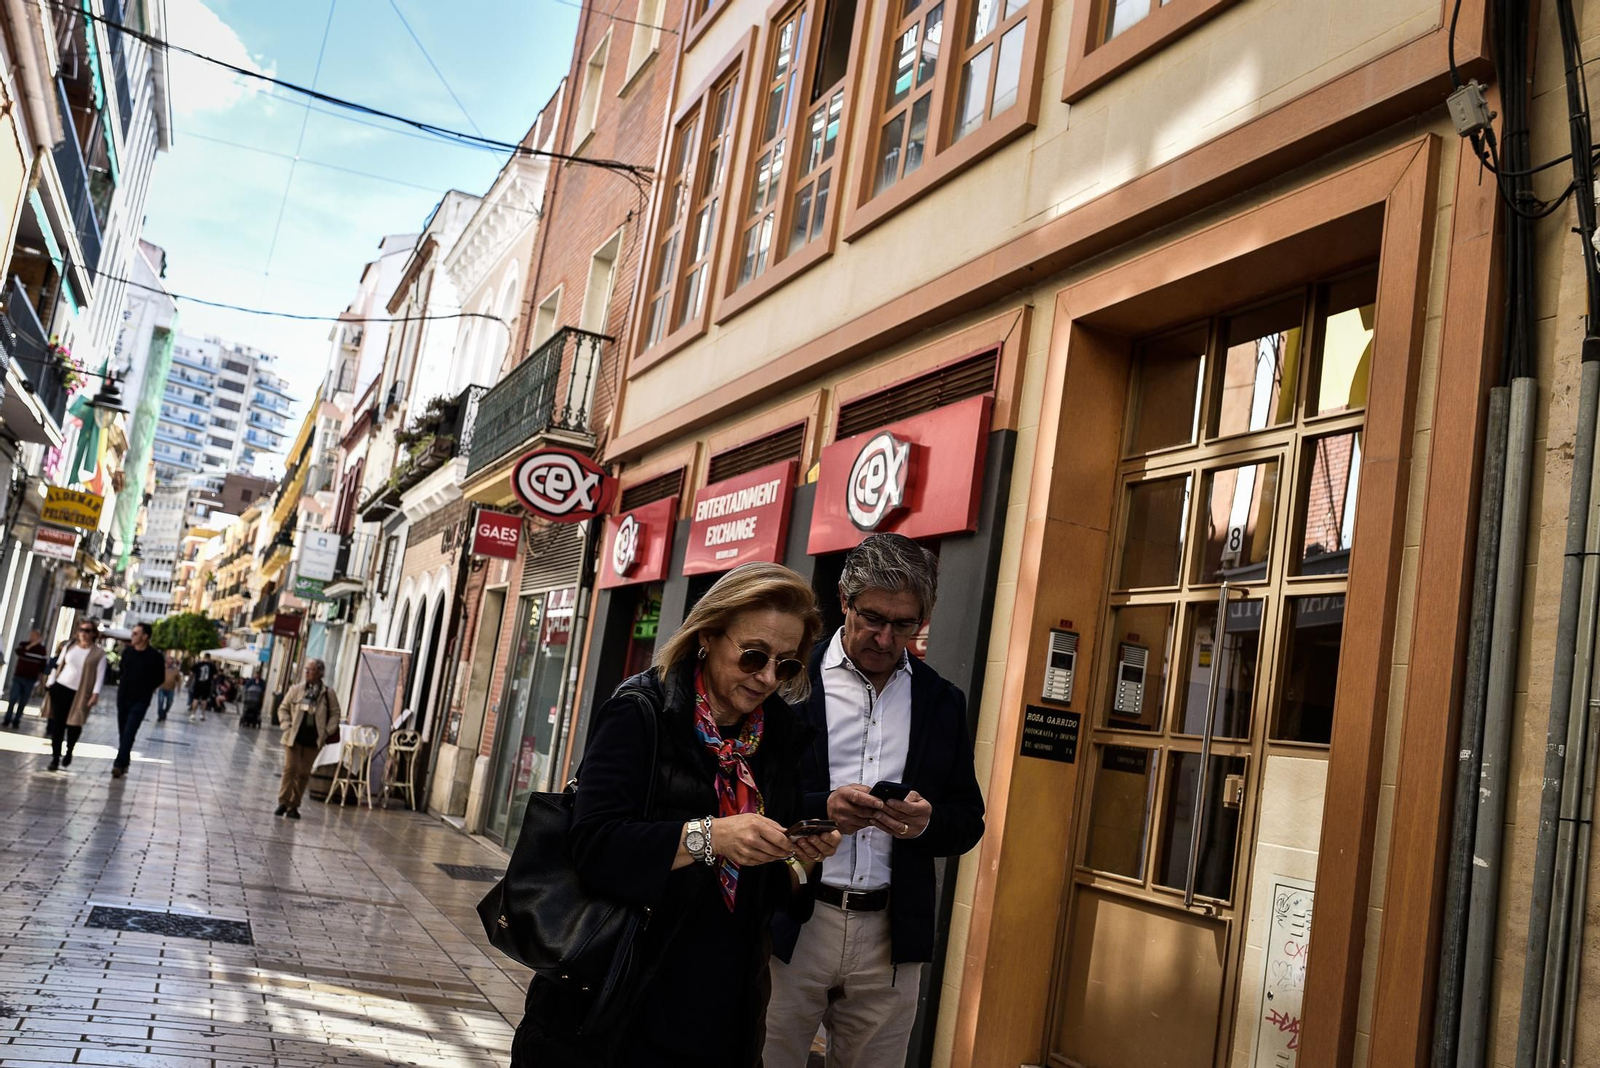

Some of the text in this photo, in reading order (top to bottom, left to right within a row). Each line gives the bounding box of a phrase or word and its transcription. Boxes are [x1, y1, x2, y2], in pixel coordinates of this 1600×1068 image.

[695, 479, 781, 522] ENTERTAINMENT
[478, 523, 518, 542] GAES
[705, 516, 758, 547] EXCHANGE
[1229, 527, 1241, 551] 8
[1026, 713, 1078, 728] ROSA GARRIDO
